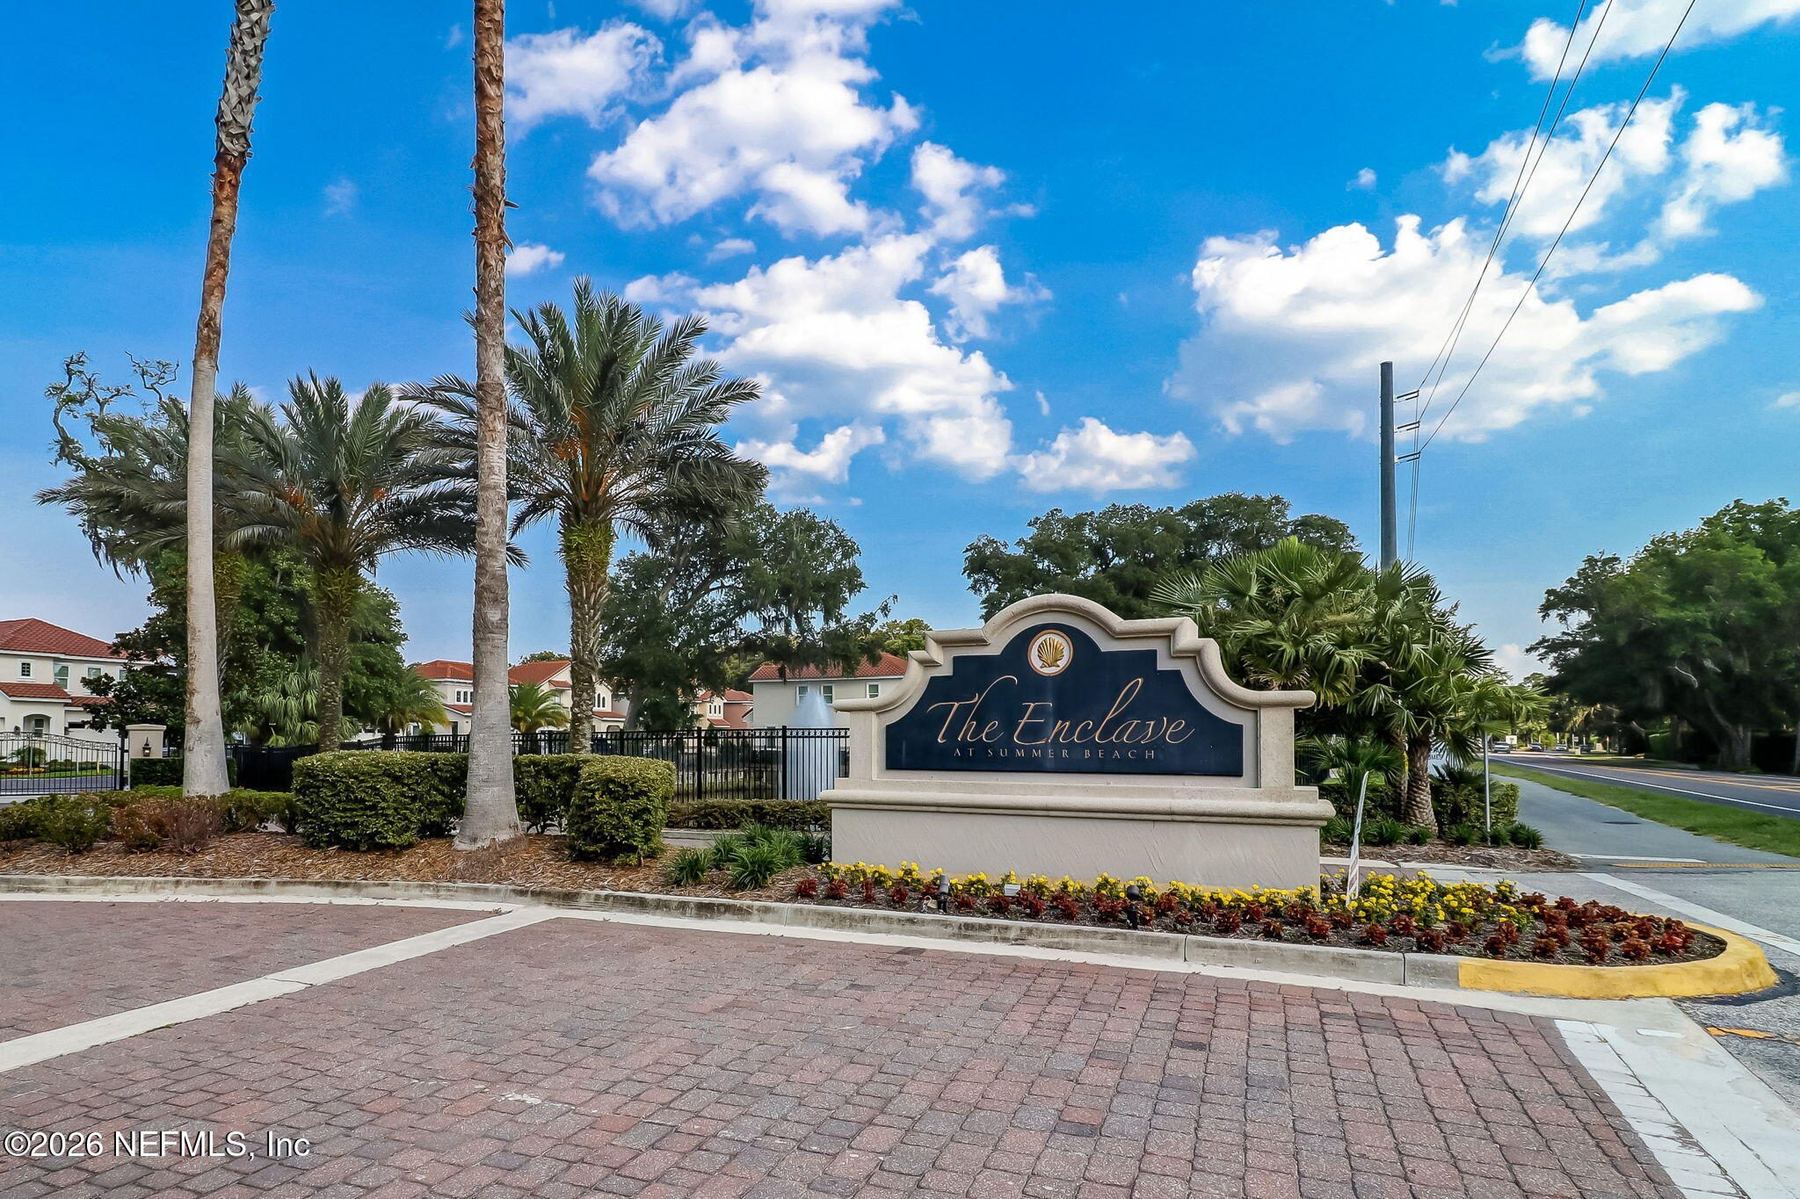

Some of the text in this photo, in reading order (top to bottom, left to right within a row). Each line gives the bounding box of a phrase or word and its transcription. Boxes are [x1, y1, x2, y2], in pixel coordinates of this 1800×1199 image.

[926, 674, 1196, 746] The Enclave
[953, 748, 1155, 760] AT SUMMER BEACH
